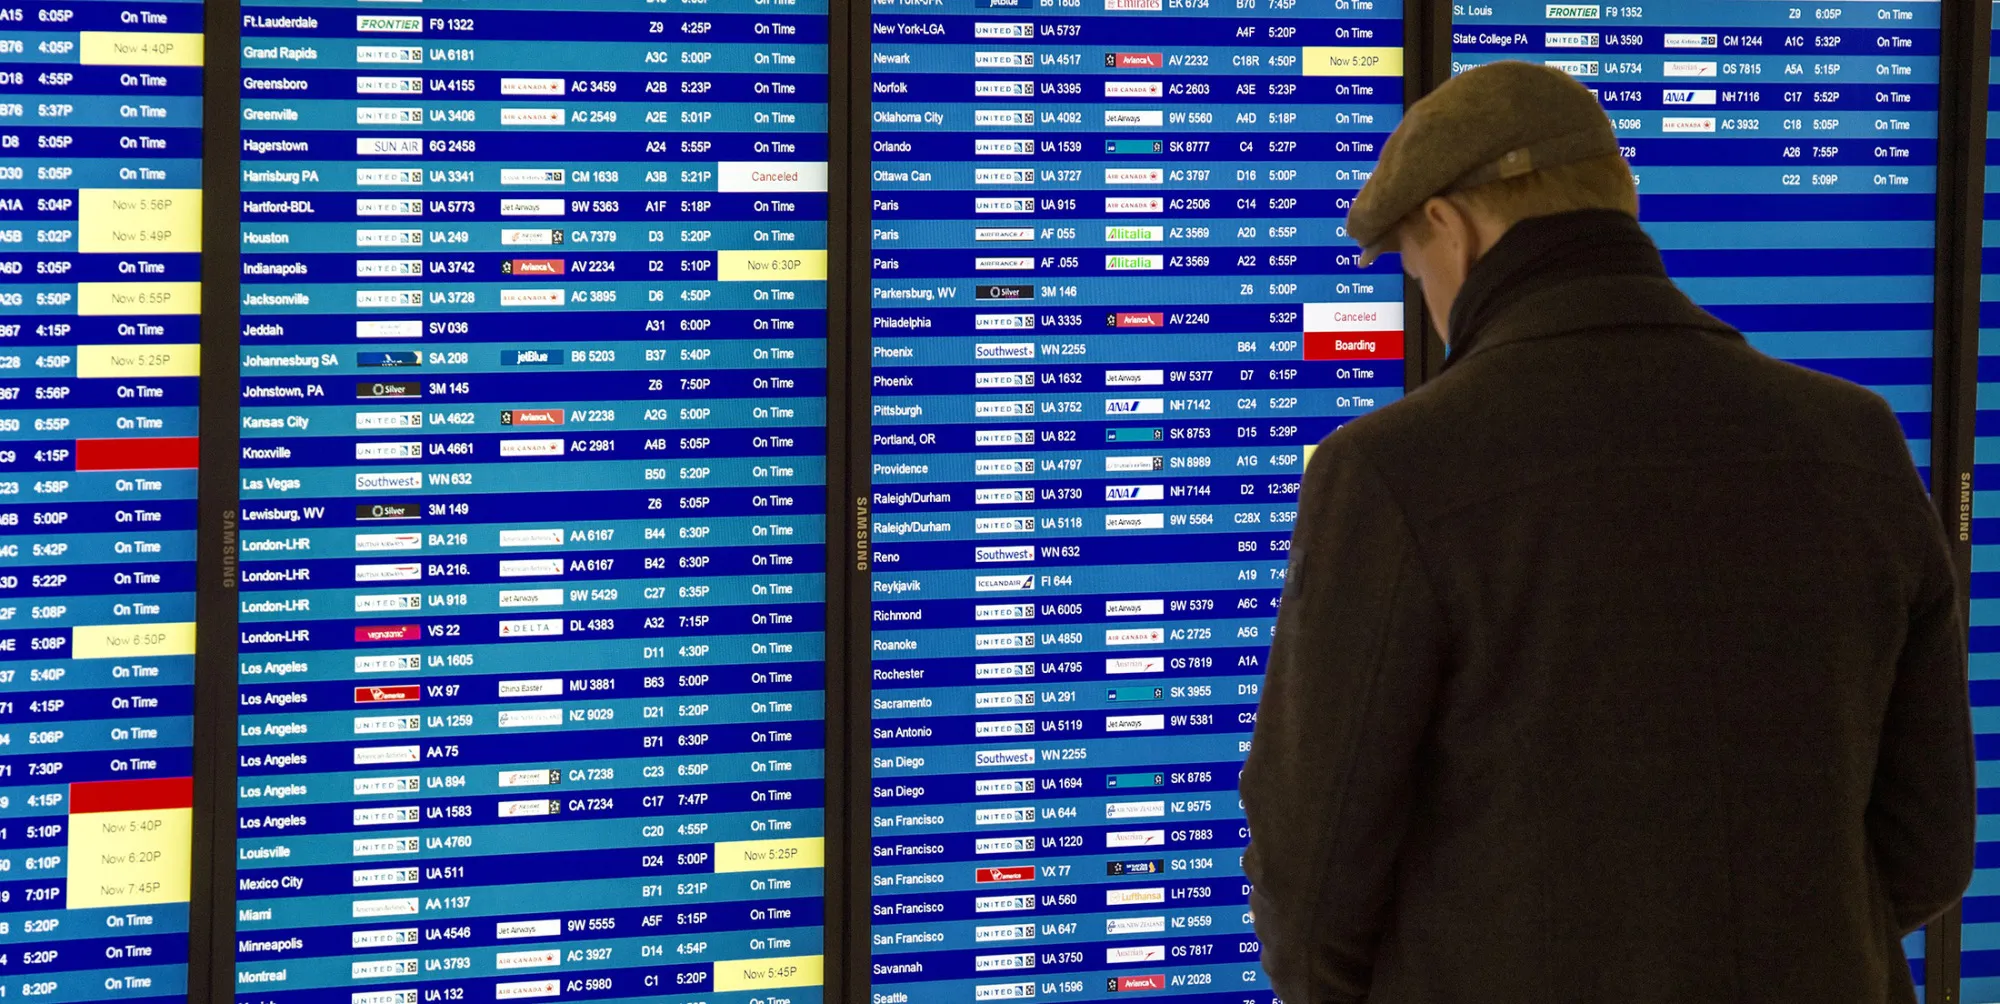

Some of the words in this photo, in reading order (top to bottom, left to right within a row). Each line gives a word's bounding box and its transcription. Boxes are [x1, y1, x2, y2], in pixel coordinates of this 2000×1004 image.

[0, 8, 23, 21] A15
[38, 9, 74, 22] 6:05P
[121, 11, 138, 23] On
[140, 11, 168, 24] Time
[1453, 5, 1465, 16] St.
[1468, 5, 1493, 16] Louis
[1549, 7, 1598, 17] FRONTIER
[1606, 7, 1618, 17] F9
[1621, 7, 1642, 17] 1352
[1789, 8, 1801, 19] Z9
[1815, 8, 1842, 19] 6:05P
[1877, 9, 1891, 20] On
[1892, 9, 1913, 20] Time
[244, 15, 318, 28] Ft.Lauderdale
[361, 19, 420, 29] FRONTIER
[430, 18, 444, 30] F9
[448, 19, 474, 31] 1322
[649, 21, 664, 33] Z9
[681, 22, 711, 33] 4:25P
[754, 23, 769, 34] On
[772, 23, 796, 34] Time
[38, 41, 74, 54] 4:05P
[114, 43, 137, 53] Now
[141, 43, 174, 54] 4:40P
[873, 53, 910, 64] Newark
[1040, 54, 1055, 65] UA
[1056, 54, 1081, 65] 4517
[1169, 55, 1183, 66] AV
[1184, 55, 1208, 66] 2232
[1232, 55, 1260, 66] C18R
[1268, 55, 1296, 66] 4:50P
[1330, 56, 1350, 66] Now
[1353, 56, 1379, 66] 5:20P
[1604, 91, 1618, 101] UA
[1620, 91, 1642, 101] 1743
[1664, 92, 1685, 102] ANA
[1722, 91, 1736, 102] NH
[1738, 91, 1760, 102] 7116
[1784, 91, 1802, 102] C17
[1814, 91, 1840, 102] 5:52P
[1875, 92, 1889, 102] On
[1890, 92, 1911, 103] Time
[2, 135, 20, 148] D8
[38, 135, 73, 148] 5:05P
[120, 136, 138, 149] On
[139, 136, 166, 149] Time
[244, 139, 308, 154] Hagerstown
[374, 142, 397, 152] SUN
[402, 141, 418, 151] AIR
[429, 140, 446, 152] 6G
[448, 140, 476, 152] 2458
[646, 141, 666, 152] A24
[681, 141, 711, 152] 5:55P
[754, 141, 769, 153] On
[771, 141, 795, 153] Time
[243, 170, 300, 185] Harrisburg
[302, 170, 319, 182] PA
[430, 170, 447, 182] UA
[448, 170, 474, 182] 3341
[572, 171, 590, 182] CM
[593, 171, 619, 183] 1638
[645, 171, 667, 182] A3B
[681, 171, 711, 182] 5:21P
[752, 171, 798, 182] Canceled
[874, 229, 899, 240] Paris
[1040, 228, 1054, 239] AF
[1057, 228, 1076, 239] 055
[1108, 228, 1152, 239] Alitalia
[1169, 227, 1183, 238] AZ
[1185, 227, 1209, 238] 3569
[1237, 227, 1256, 238] A20
[1269, 227, 1297, 238] 6:55P
[244, 262, 308, 276] Indianapolis
[430, 261, 446, 273] UA
[448, 261, 475, 273] 3742
[571, 261, 587, 272] AV
[588, 261, 615, 272] 2234
[649, 260, 664, 272] D2
[681, 260, 711, 271] 5:10P
[748, 260, 769, 270] Now
[772, 259, 802, 270] 6:30P
[874, 317, 931, 330] Philadelphia
[1041, 315, 1056, 326] UA
[1058, 315, 1082, 326] 3335
[1169, 314, 1184, 324] AV
[1185, 313, 1210, 324] 2240
[1269, 312, 1297, 323] 5:32P
[1334, 312, 1377, 322] Canceled
[874, 346, 913, 357] Phoenix
[976, 346, 1028, 357] Southwest
[1041, 344, 1060, 355] WN
[1061, 344, 1086, 355] 2255
[1237, 341, 1256, 352] B64
[1269, 341, 1297, 352] 4:00P
[1335, 340, 1376, 352] Boarding
[243, 354, 319, 368] Johannesburg
[321, 354, 339, 366] SA
[429, 352, 446, 364] SA
[447, 352, 468, 364] 208
[517, 350, 548, 364] jetBlue
[571, 351, 586, 362] B6
[589, 350, 615, 362] 5203
[645, 349, 666, 361] B37
[680, 349, 711, 360] 5:40P
[753, 348, 768, 359] On
[770, 348, 794, 359] Time
[1959, 472, 1971, 541] SAMSUNG
[857, 497, 867, 570] SAMSUNG
[223, 510, 235, 588] SAMSUNG
[874, 580, 921, 594] Reykjavik
[978, 580, 1021, 588] ICELANDAIR
[1041, 576, 1051, 587] FI
[1053, 575, 1072, 586] 644
[1238, 569, 1257, 580] A19
[242, 629, 309, 644] London-LHR
[428, 625, 444, 636] VS
[446, 624, 460, 636] 22
[514, 623, 550, 633] DELTA
[570, 620, 585, 631] DL
[587, 618, 614, 630] 4383
[644, 617, 664, 628] A32
[679, 615, 709, 627] 7:15P
[752, 613, 767, 624] On
[769, 613, 793, 624] Time
[31, 637, 66, 650] 5:08P
[107, 636, 130, 646] Now
[133, 633, 167, 646] 6:50P
[240, 878, 279, 890] Mexico
[281, 876, 303, 890] City
[426, 867, 443, 879] UA
[444, 866, 463, 878] 511
[642, 855, 664, 867] D24
[677, 852, 708, 865] 5:00P
[744, 851, 766, 860] Now
[769, 848, 798, 860] 5:25P
[25, 887, 60, 901] 7:01P
[101, 886, 123, 895] Now
[128, 882, 161, 894] 7:45P
[873, 904, 893, 916] San
[896, 902, 944, 914] Francisco
[1042, 895, 1057, 906] UA
[1058, 894, 1077, 905] 560
[1121, 891, 1162, 901] Lufthansa
[1171, 888, 1185, 899] LH
[1187, 886, 1211, 898] 7530
